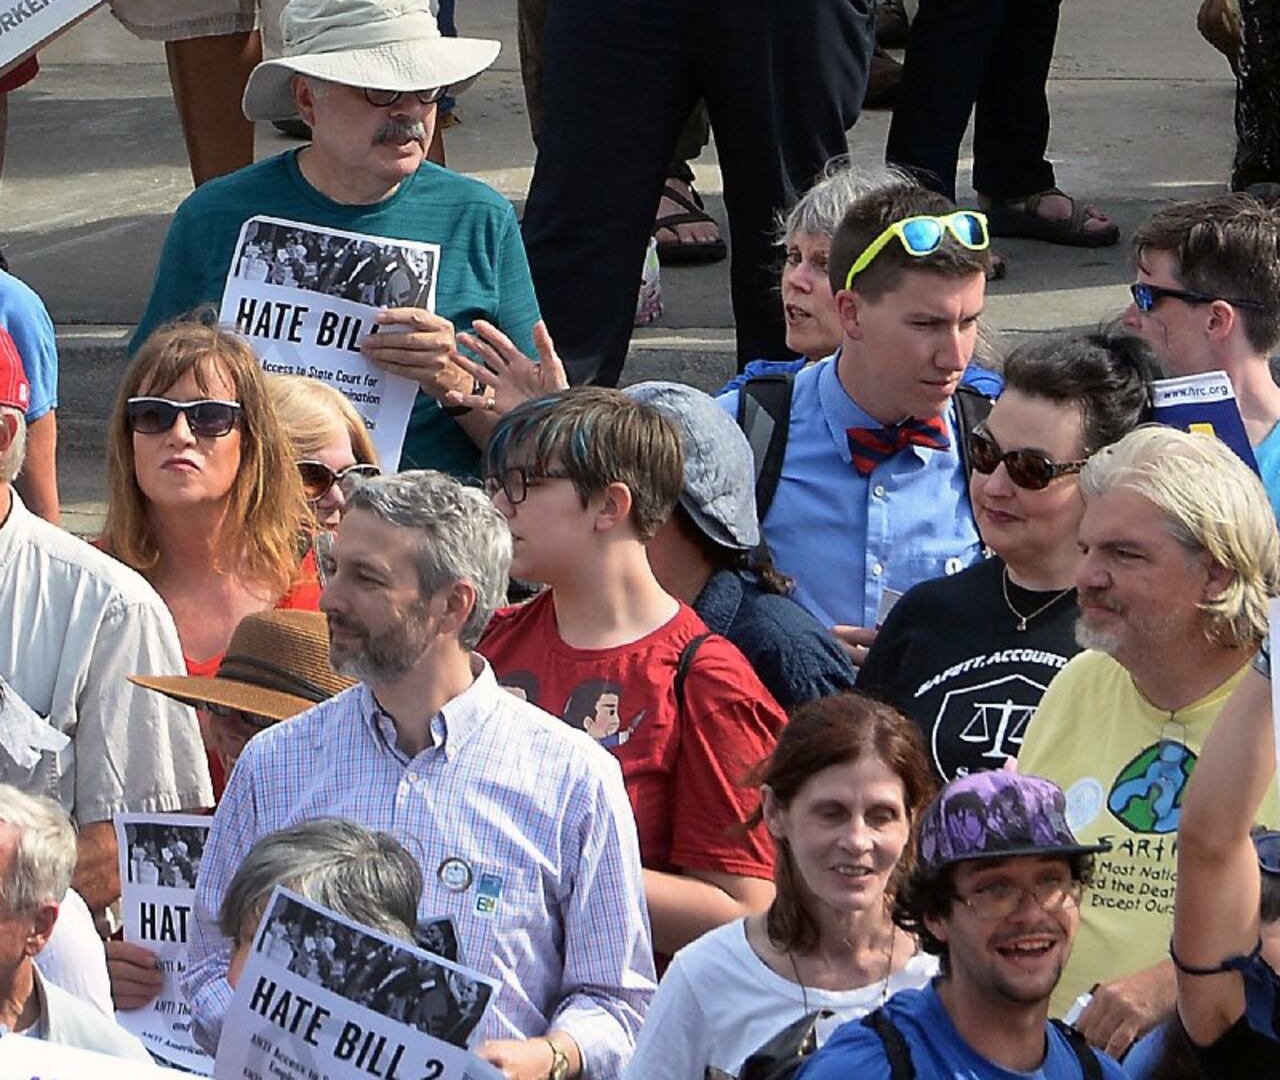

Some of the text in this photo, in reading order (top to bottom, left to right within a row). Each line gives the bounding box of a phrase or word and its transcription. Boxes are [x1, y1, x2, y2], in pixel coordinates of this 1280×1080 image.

[235, 297, 309, 343] HATE
[296, 365, 306, 377] to
[308, 366, 334, 381] State
[336, 370, 361, 386] Court
[364, 375, 378, 388] for
[987, 649, 1068, 669] ACCOUNT
[1100, 861, 1136, 876] Most
[1112, 878, 1175, 899] the Deat
[1091, 893, 1141, 912] Except
[140, 902, 191, 943] HAT
[154, 1000, 175, 1016] ANTI
[249, 975, 331, 1047] HATE
[333, 1020, 406, 1080] BILL
